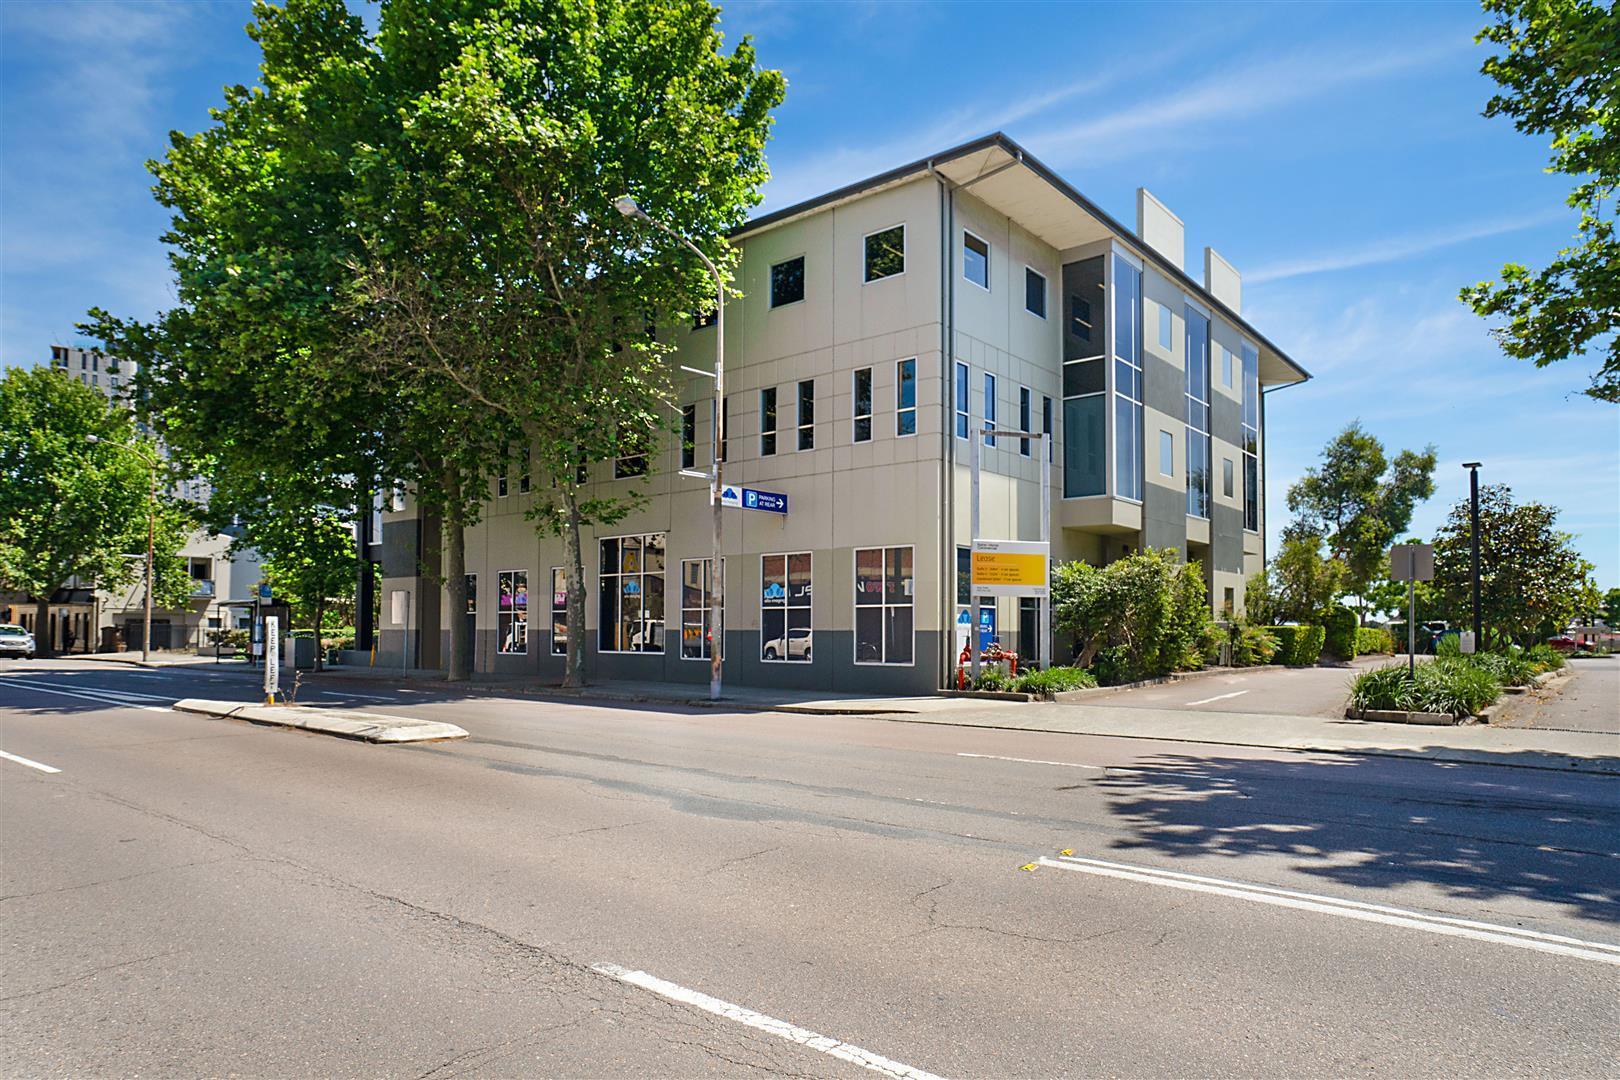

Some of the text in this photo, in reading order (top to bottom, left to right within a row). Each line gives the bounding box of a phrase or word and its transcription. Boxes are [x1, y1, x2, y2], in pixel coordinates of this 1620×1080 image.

[748, 493, 756, 505] P
[758, 494, 776, 502] PARKING
[976, 554, 996, 562] Lease
